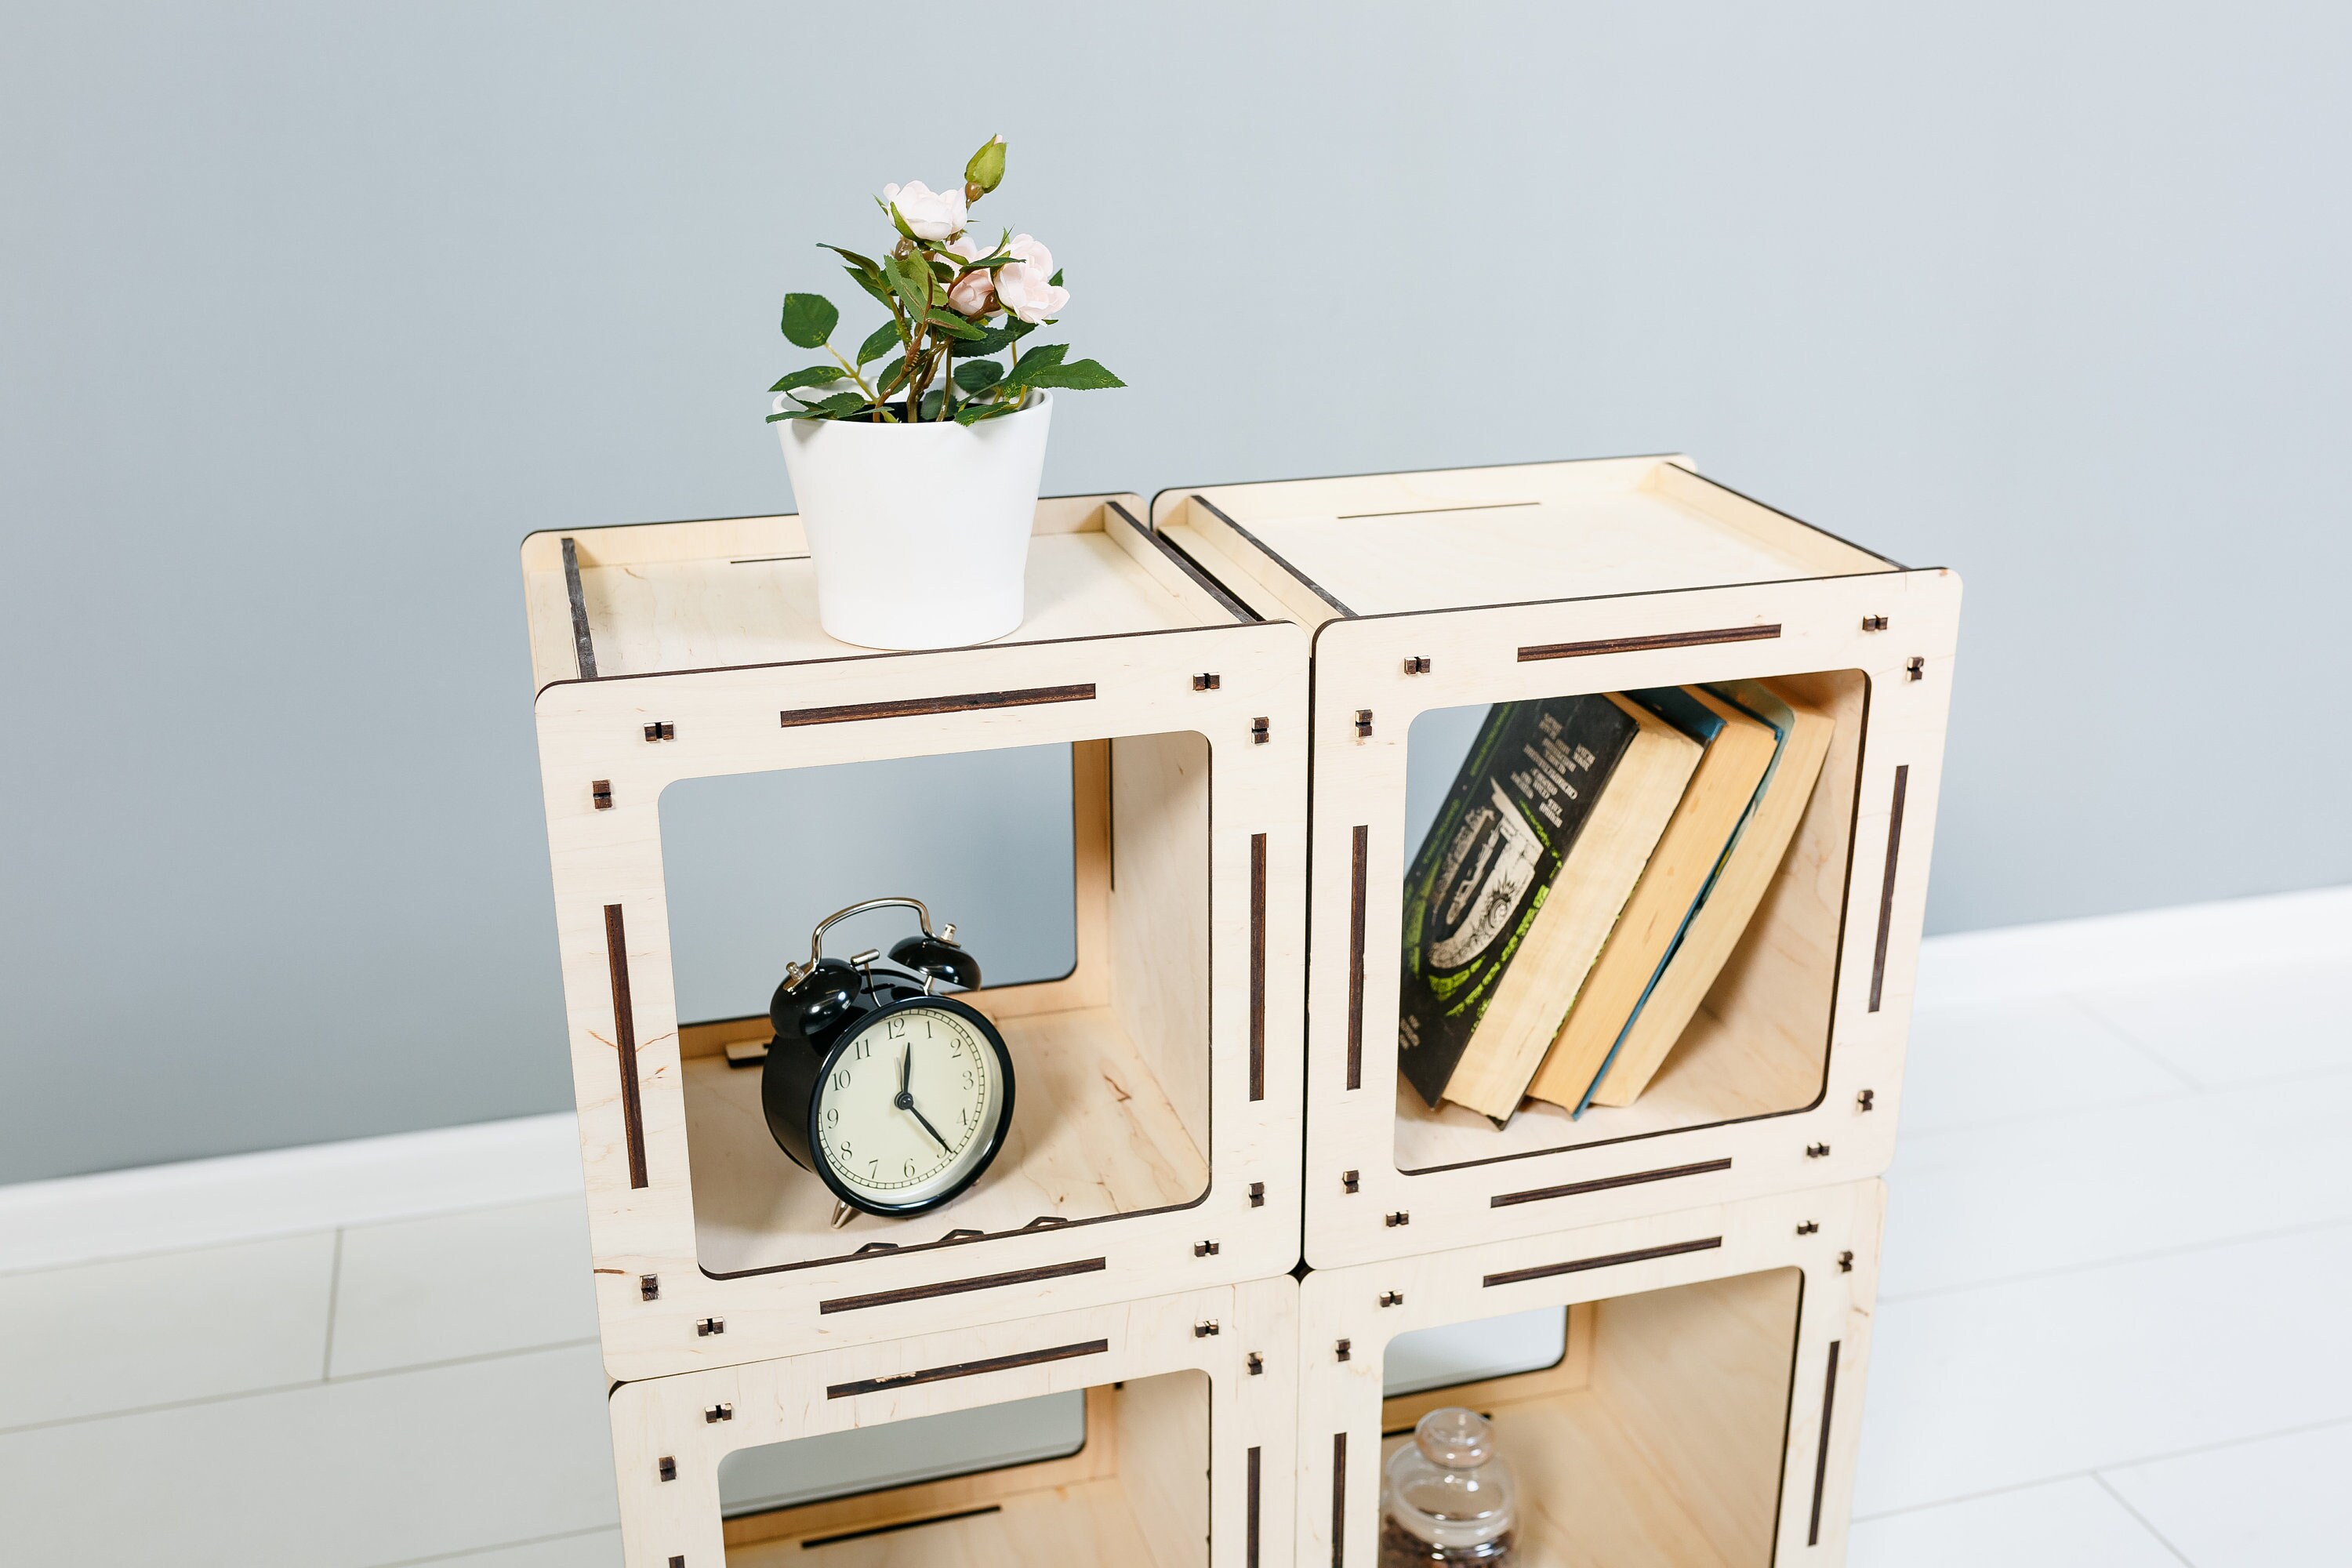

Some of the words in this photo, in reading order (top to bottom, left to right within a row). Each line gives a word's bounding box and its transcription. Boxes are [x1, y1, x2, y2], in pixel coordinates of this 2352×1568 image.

[886, 1018, 906, 1040] 12
[925, 1021, 934, 1039] 1
[854, 1038, 871, 1060] 11
[949, 1038, 963, 1058] 2
[832, 1069, 851, 1091] 10
[962, 1070, 974, 1091] 3
[826, 1109, 839, 1129] 9
[956, 1108, 970, 1126] 4
[840, 1142, 853, 1161] 8
[867, 1159, 880, 1179] 7
[903, 1158, 915, 1178] 6
